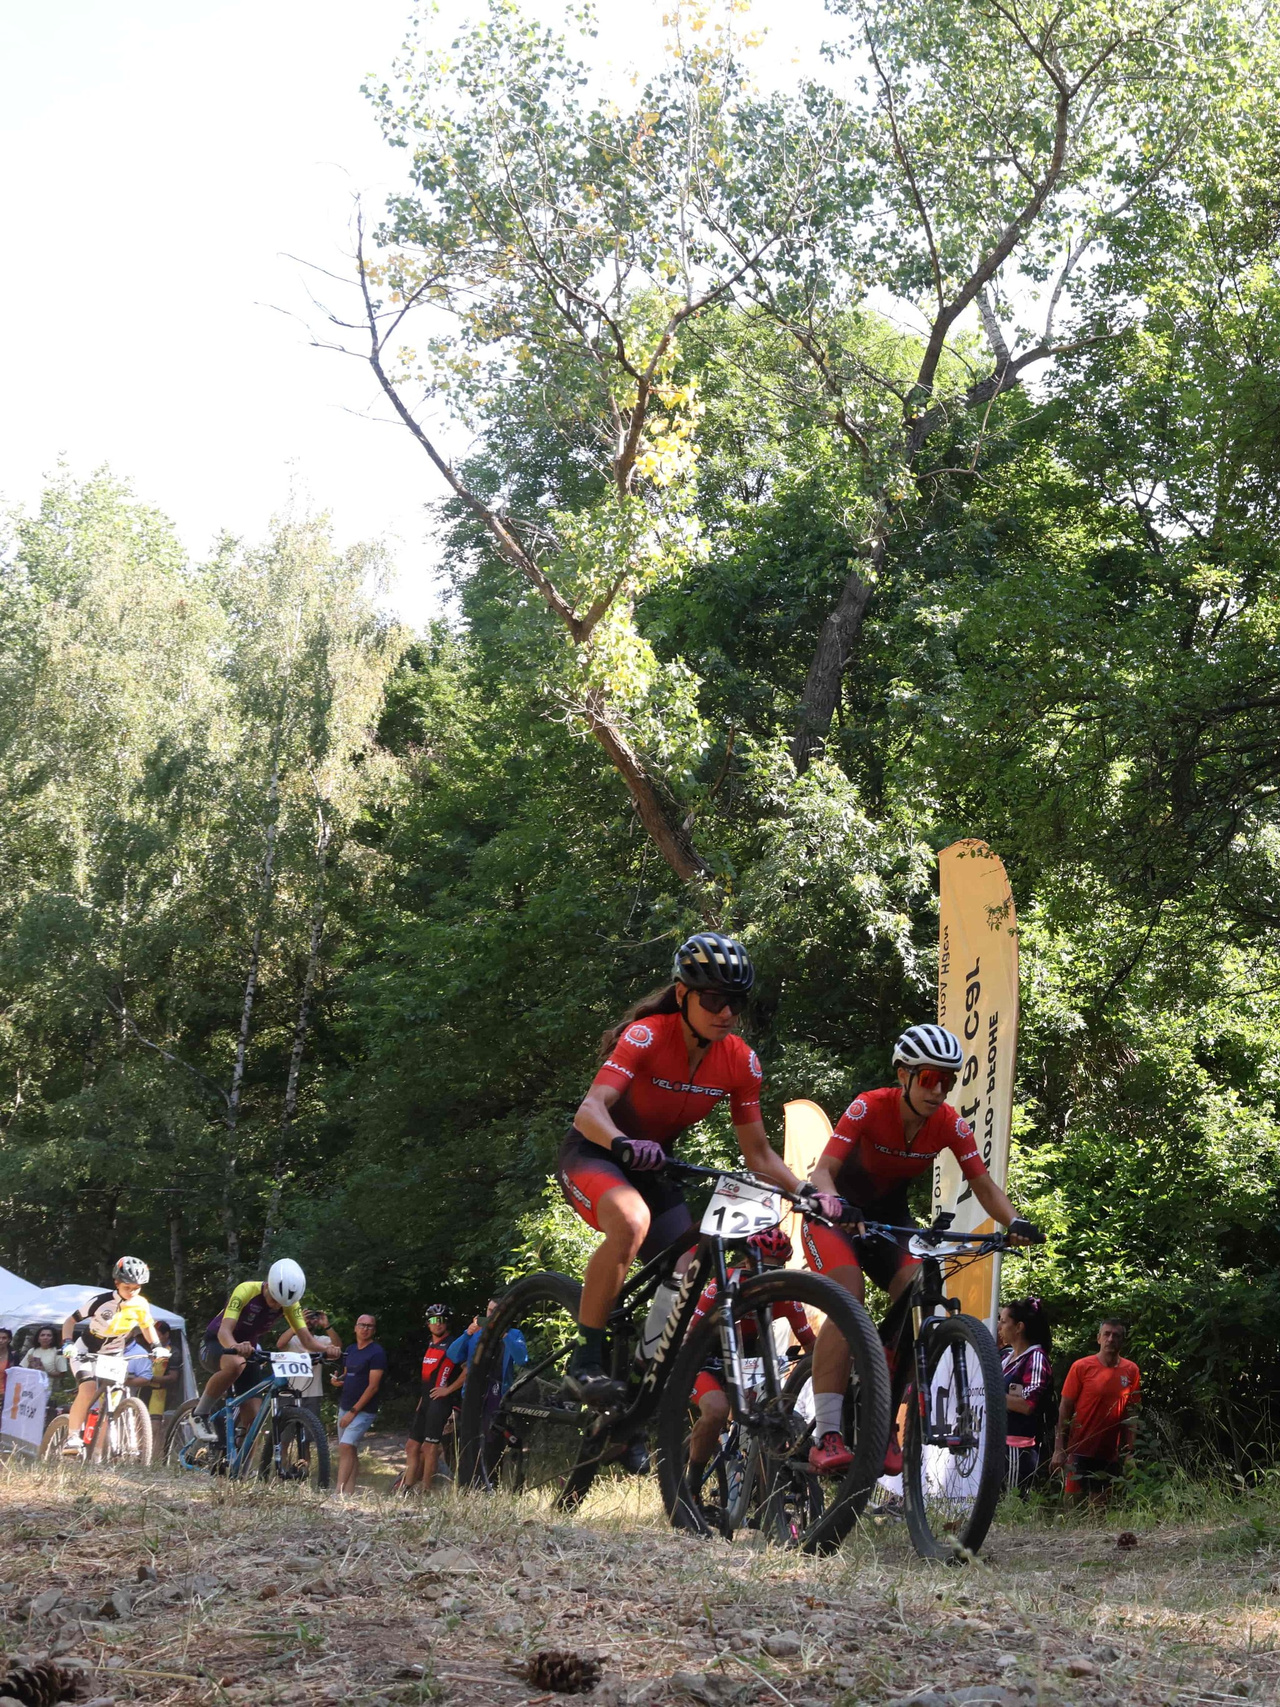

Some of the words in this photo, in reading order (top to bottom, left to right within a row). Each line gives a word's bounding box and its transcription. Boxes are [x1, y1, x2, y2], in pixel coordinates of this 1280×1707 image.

[712, 1205, 773, 1234] 125
[643, 1258, 701, 1393] S-WORKS
[277, 1362, 309, 1375] 100
[510, 1405, 551, 1418] SPECIALIZED
